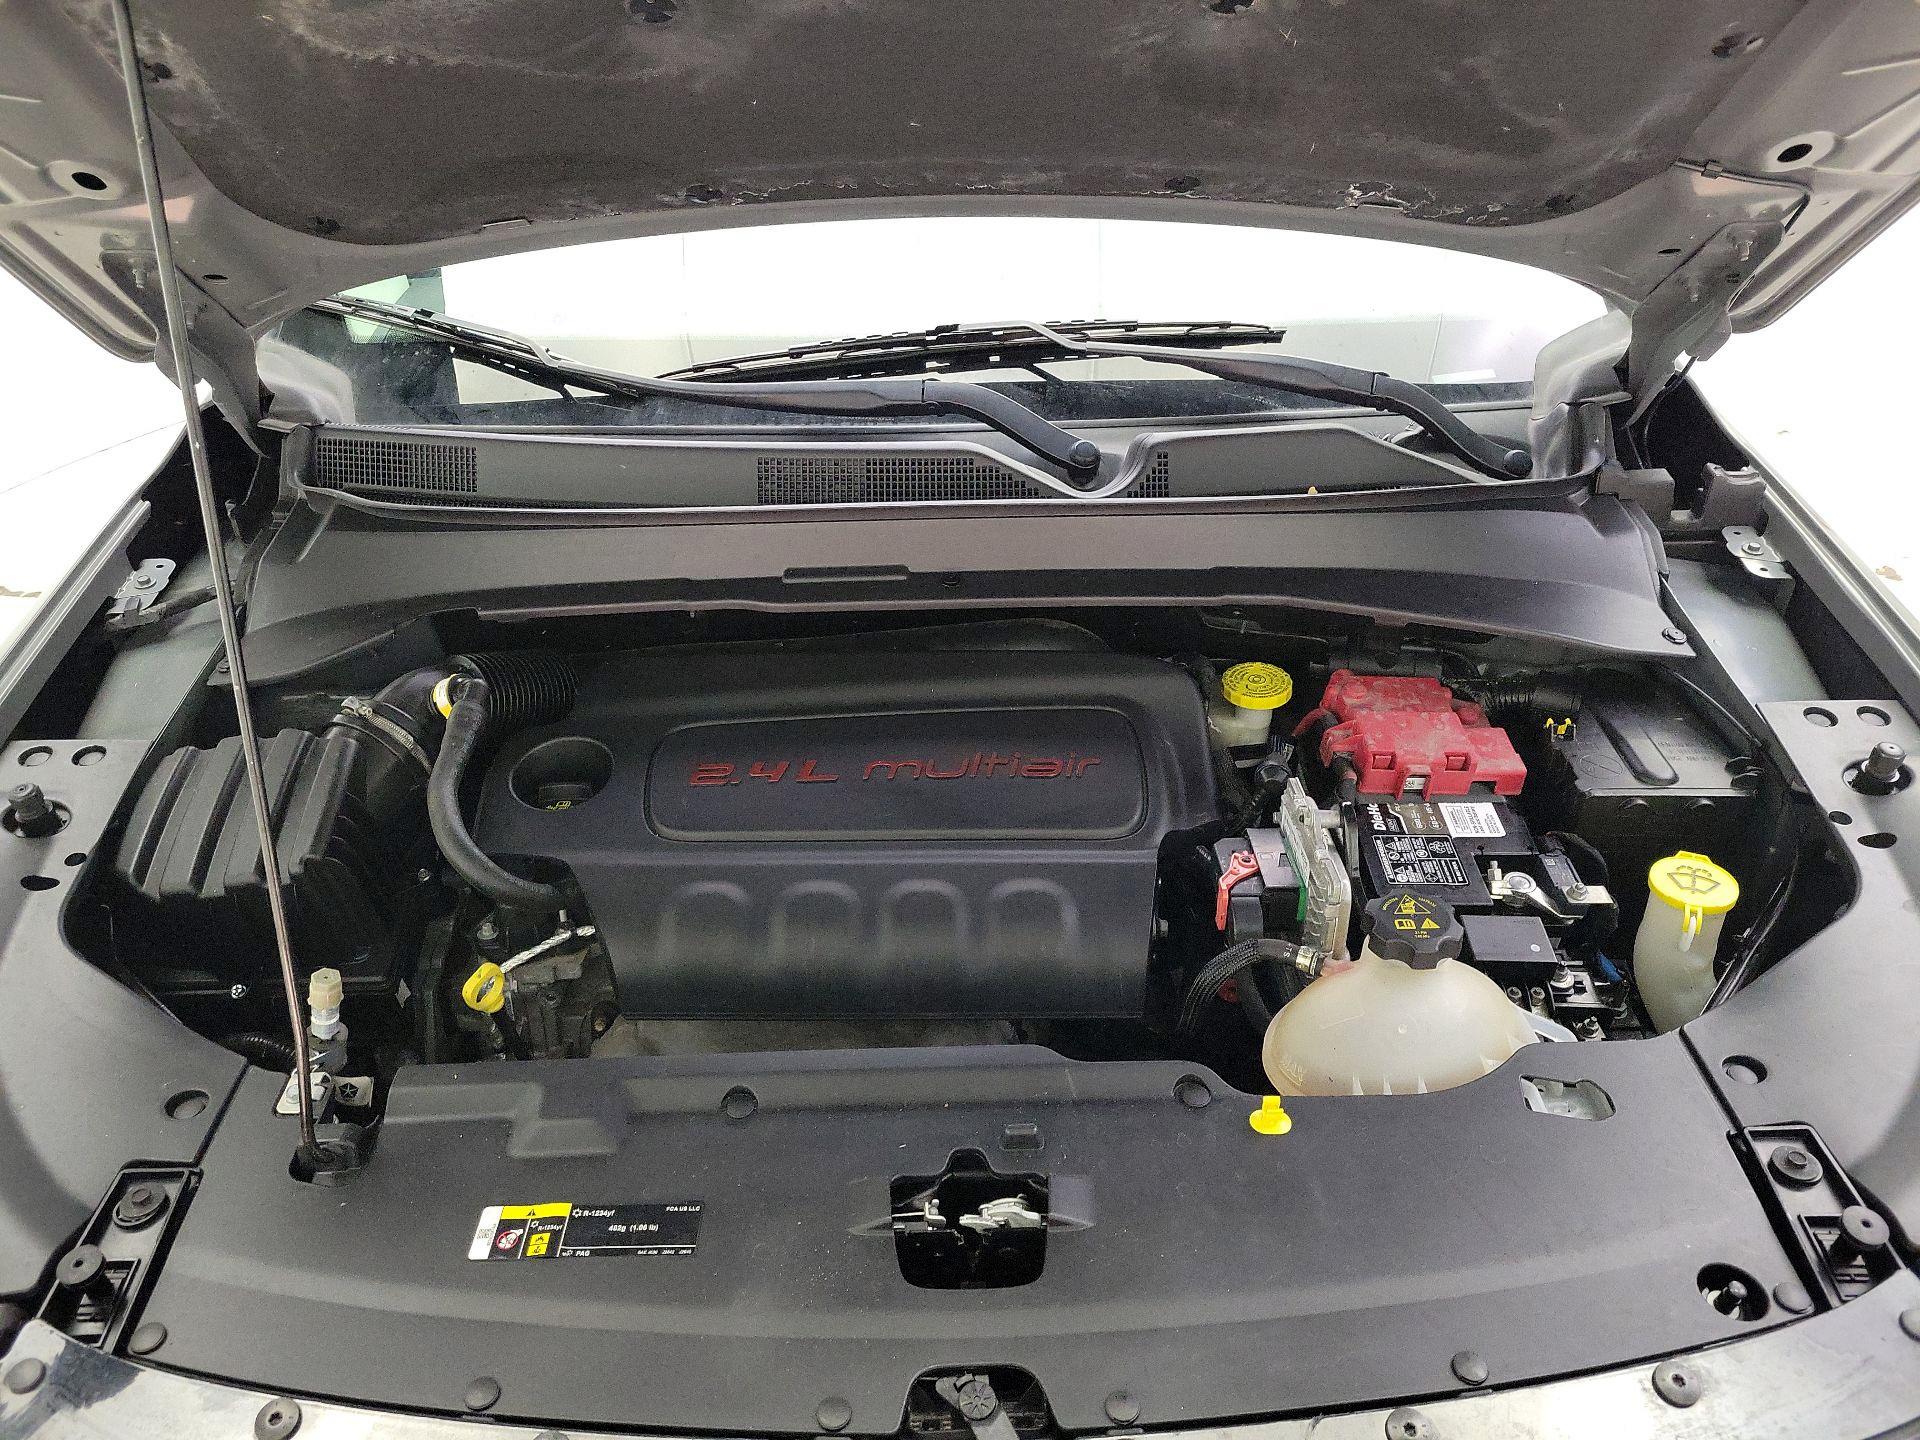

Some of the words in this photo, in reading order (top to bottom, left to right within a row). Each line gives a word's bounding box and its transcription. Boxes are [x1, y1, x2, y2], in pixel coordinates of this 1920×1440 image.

[688, 757, 839, 787] 2.4L
[862, 750, 1101, 780] multiair
[582, 1208, 615, 1218] R-1234yf
